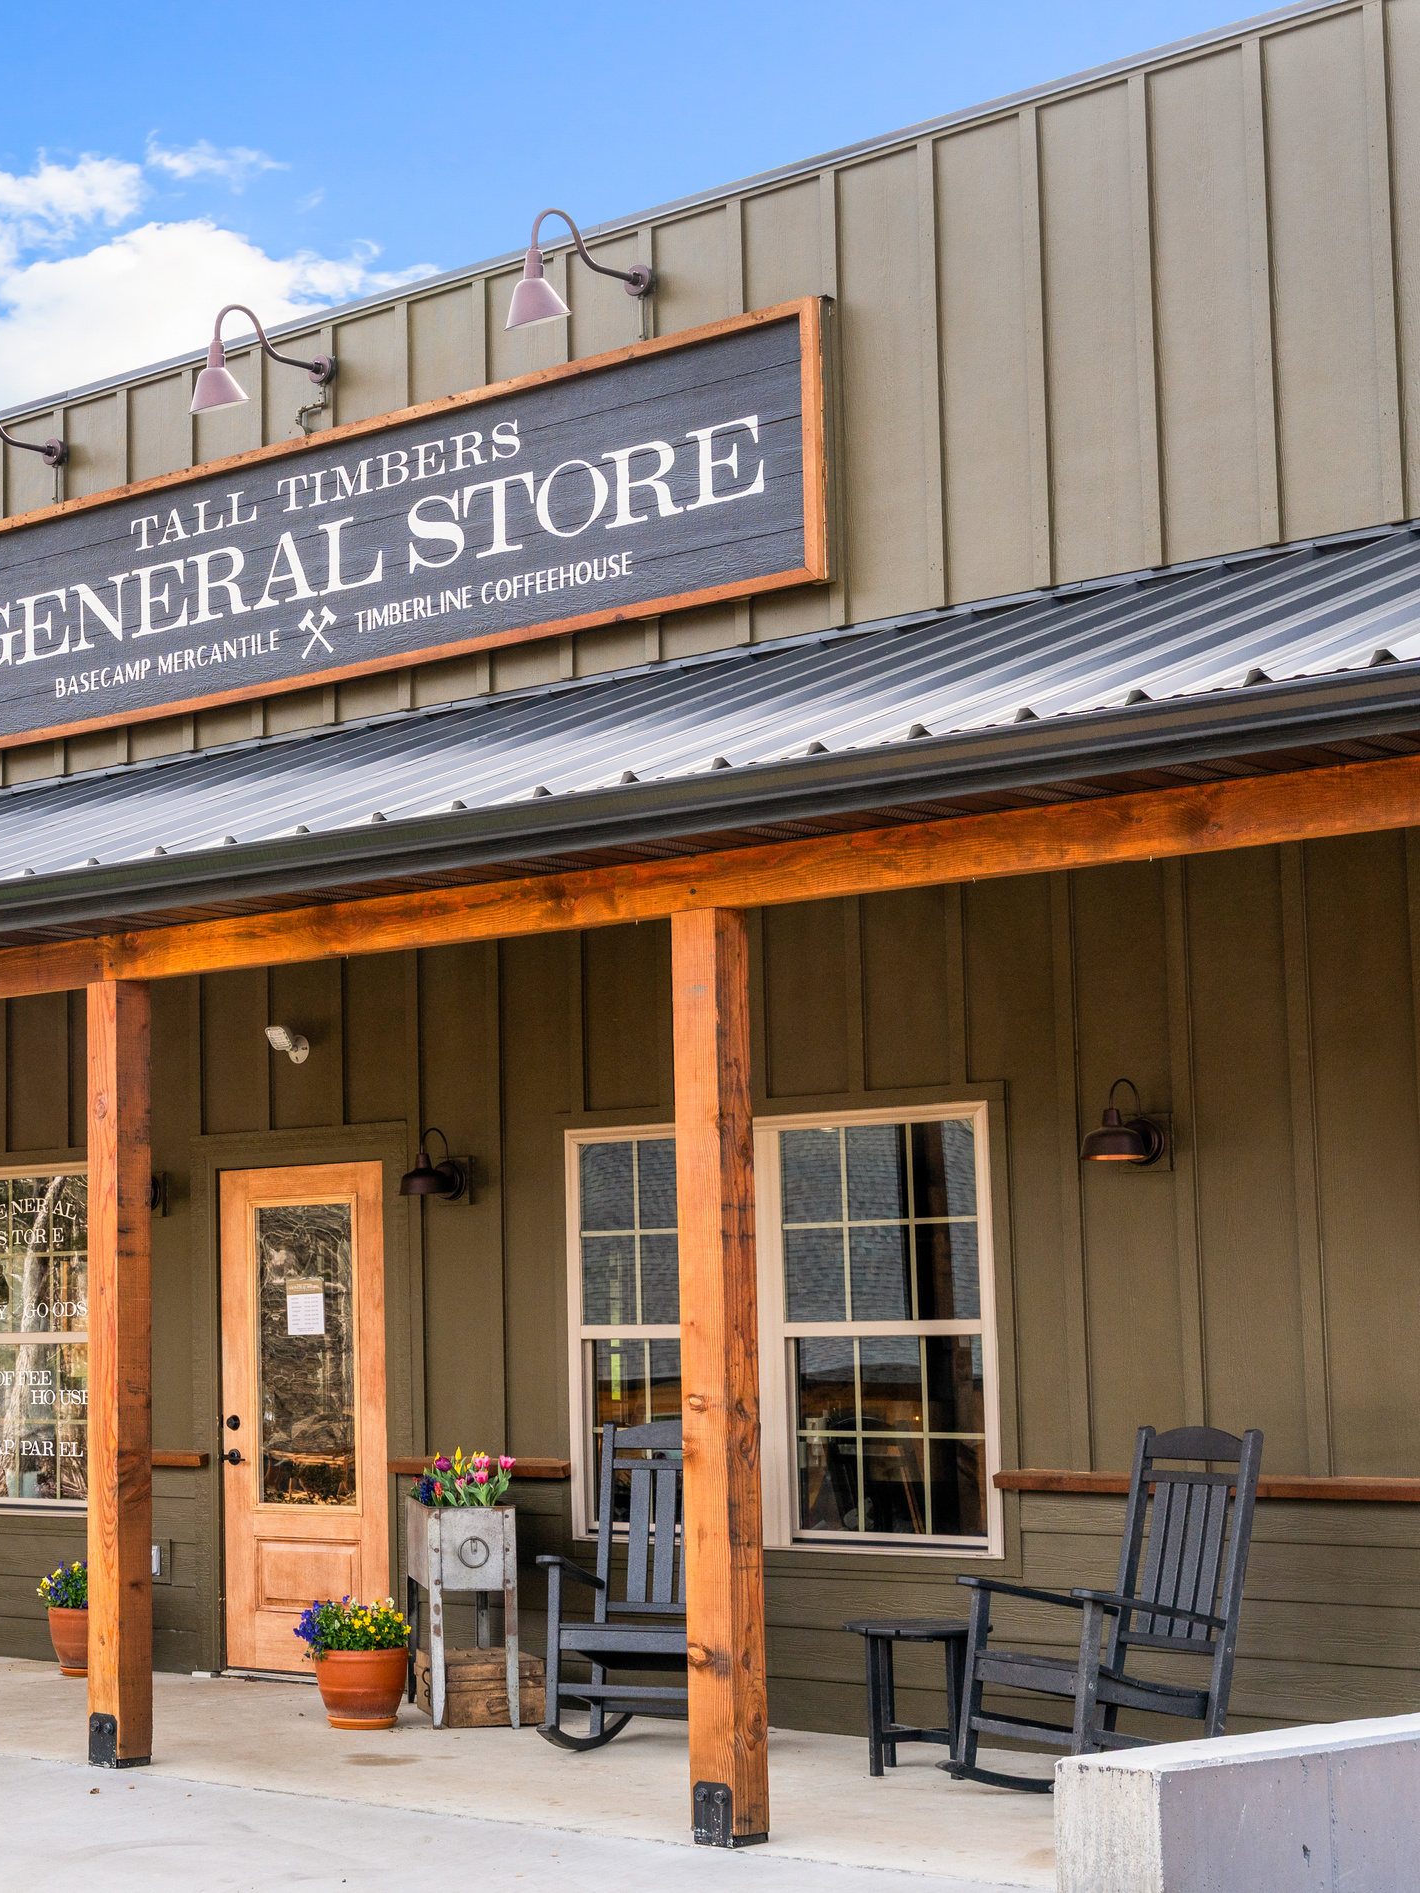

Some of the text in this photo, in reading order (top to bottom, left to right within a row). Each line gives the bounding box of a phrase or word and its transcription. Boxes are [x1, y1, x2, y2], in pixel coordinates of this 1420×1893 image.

[131, 418, 521, 552] TALL TIMBERS
[406, 414, 766, 575] STORE
[353, 550, 635, 634] TIMBERLINE COFFEEHOUSE
[54, 627, 281, 700] BASECAMP MERCANTILE
[23, 1301, 88, 1319] GOODS
